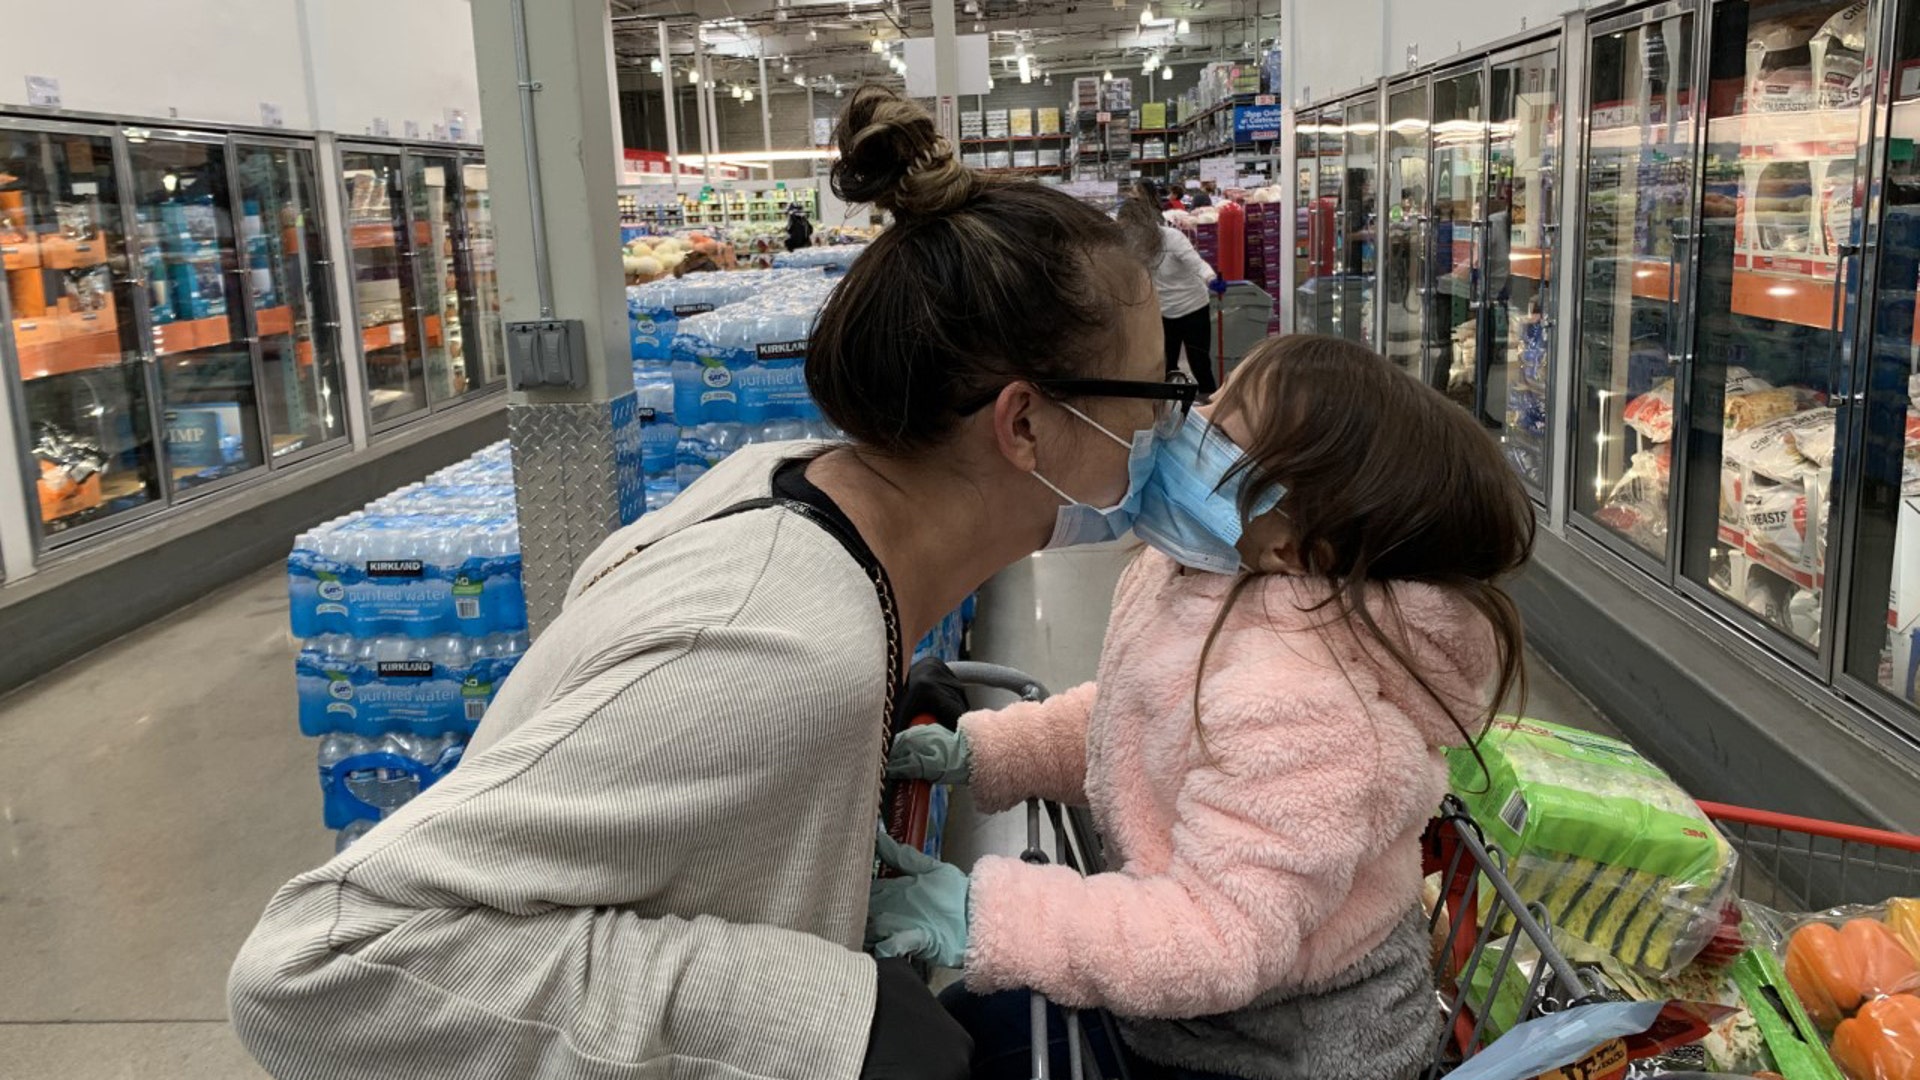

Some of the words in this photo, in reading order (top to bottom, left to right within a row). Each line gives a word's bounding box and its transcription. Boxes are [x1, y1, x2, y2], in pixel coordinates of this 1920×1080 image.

[738, 372, 794, 389] purified
[370, 562, 421, 572] KIRKLAND
[349, 588, 401, 604] purified
[404, 588, 447, 602] water
[380, 662, 431, 673] KIRKLAND
[358, 687, 412, 704] purified
[414, 687, 455, 703] water
[1682, 827, 1708, 840] 3M
